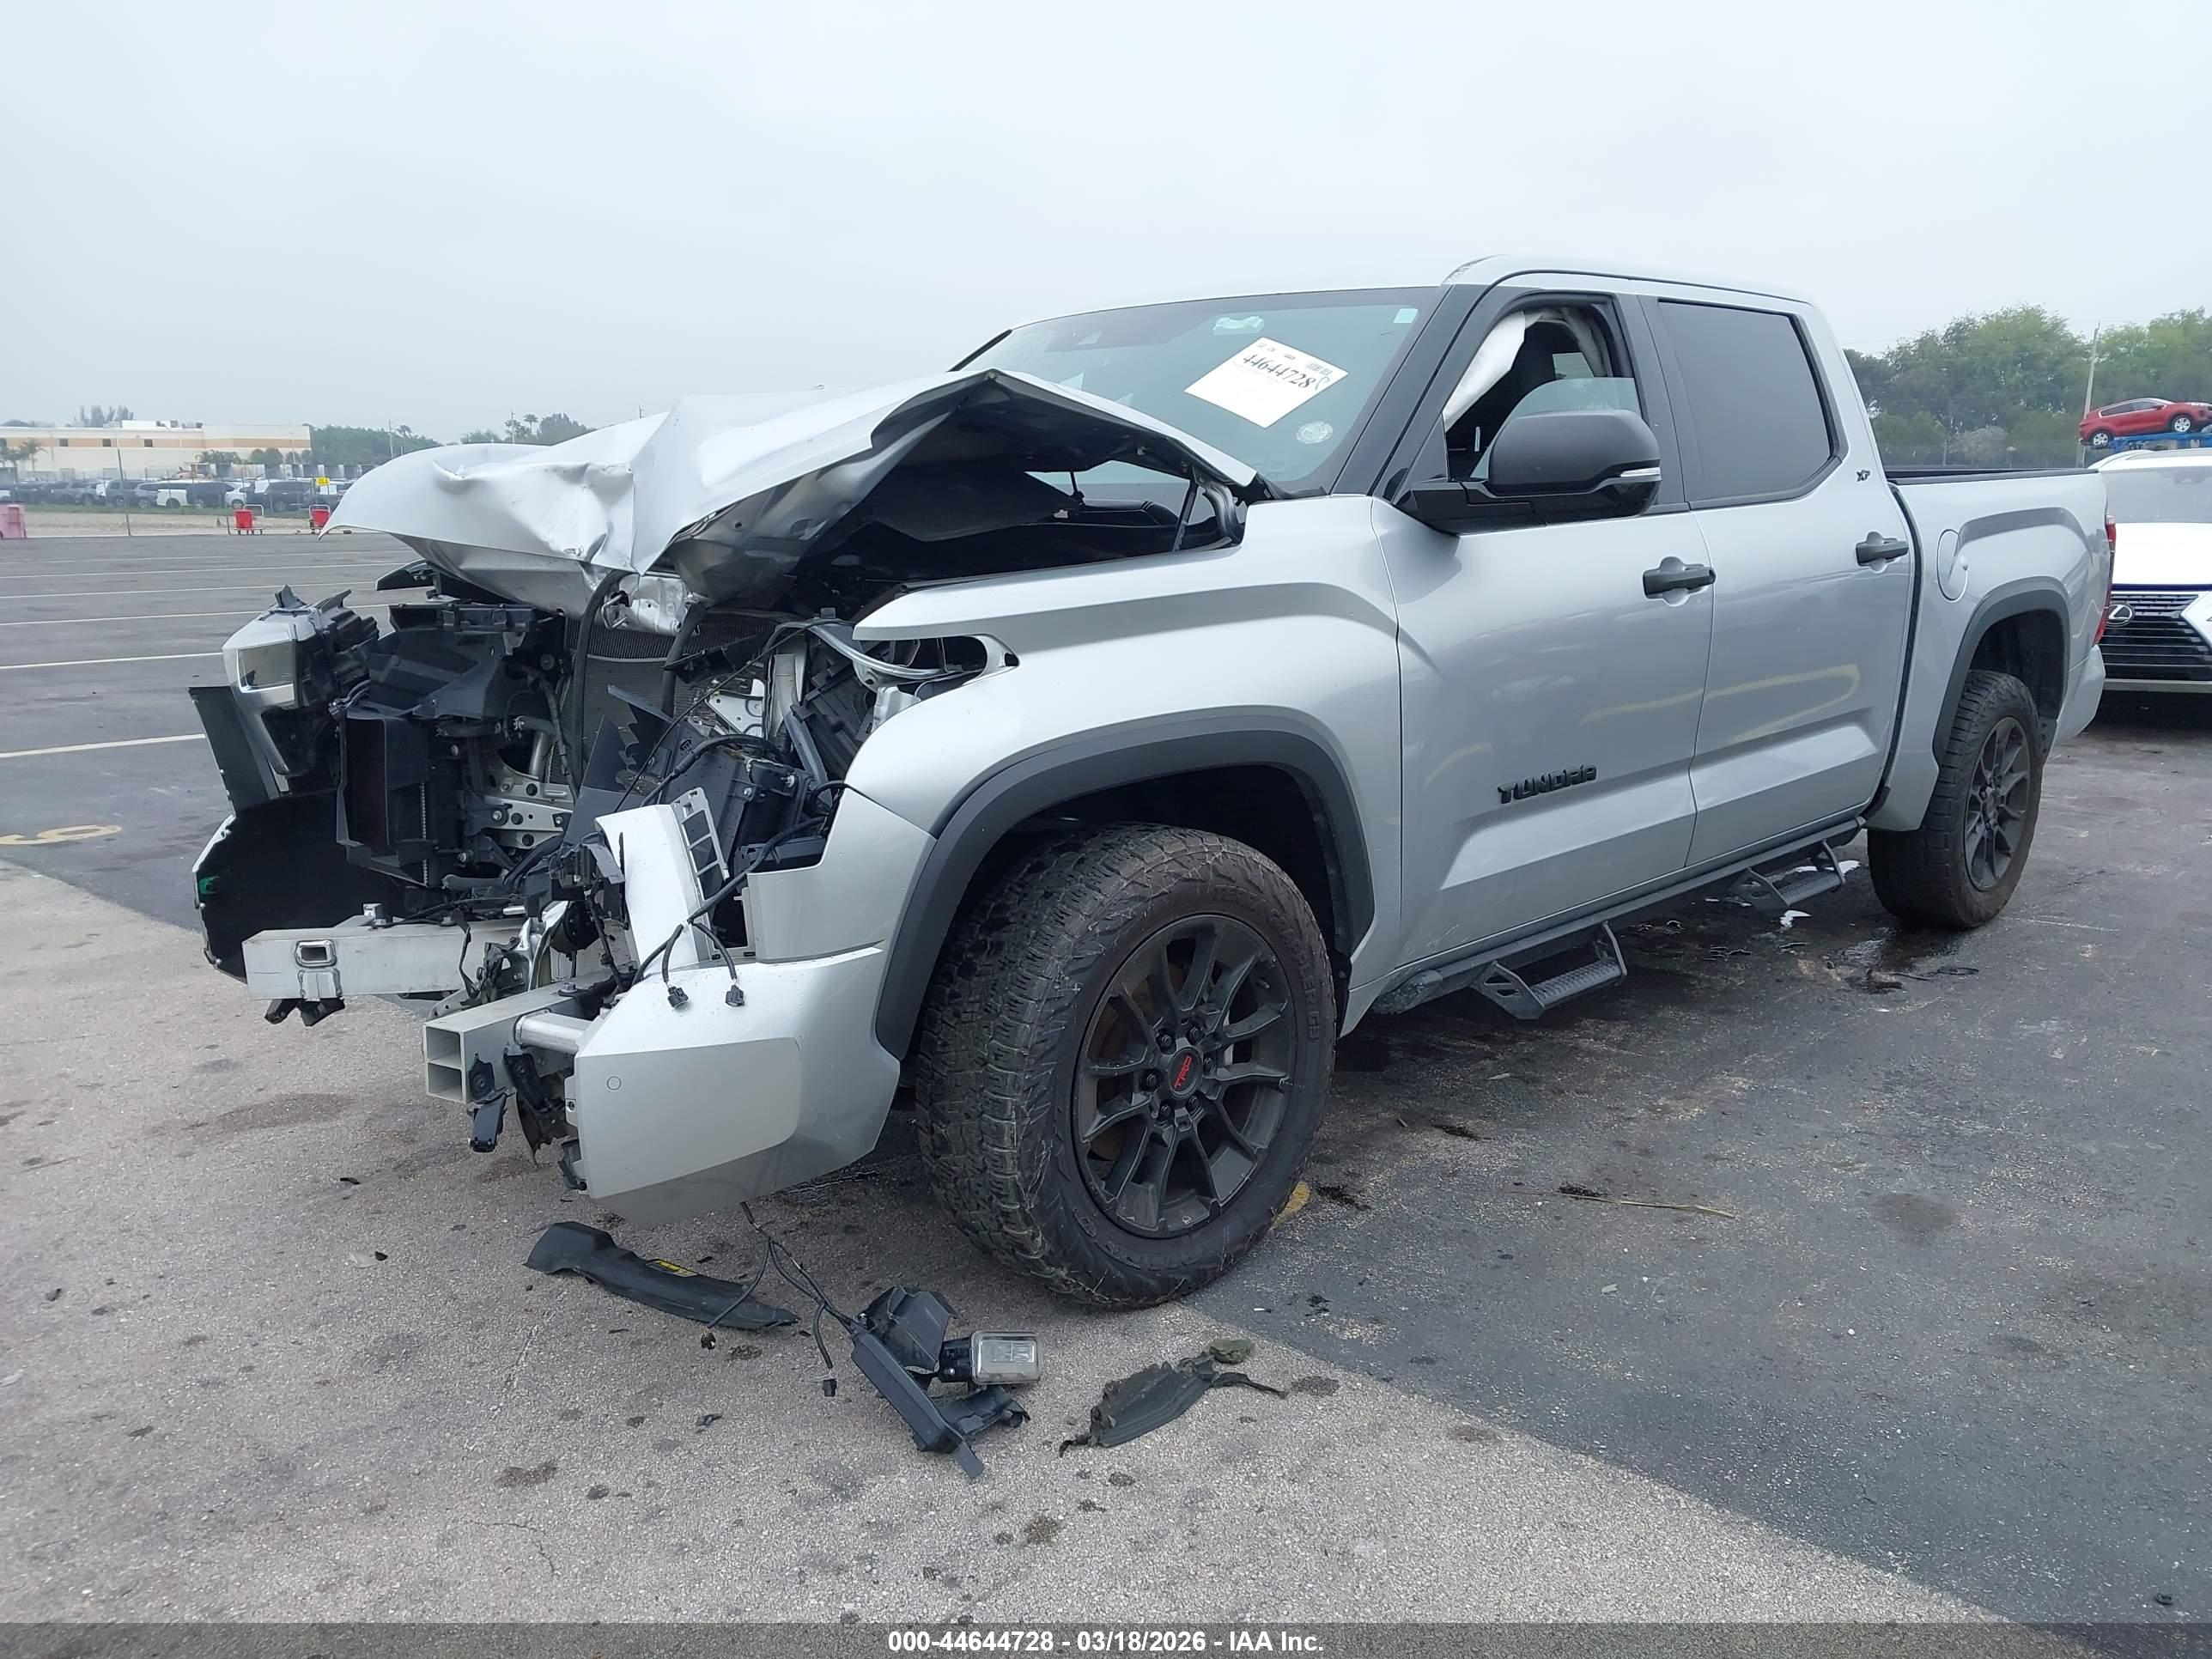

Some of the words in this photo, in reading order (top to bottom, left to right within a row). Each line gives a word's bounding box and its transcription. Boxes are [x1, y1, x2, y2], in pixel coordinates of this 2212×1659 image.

[1243, 353, 1316, 389] 44644728
[1497, 763, 1597, 805] TUNDRA
[1173, 1054, 1194, 1091] TRD
